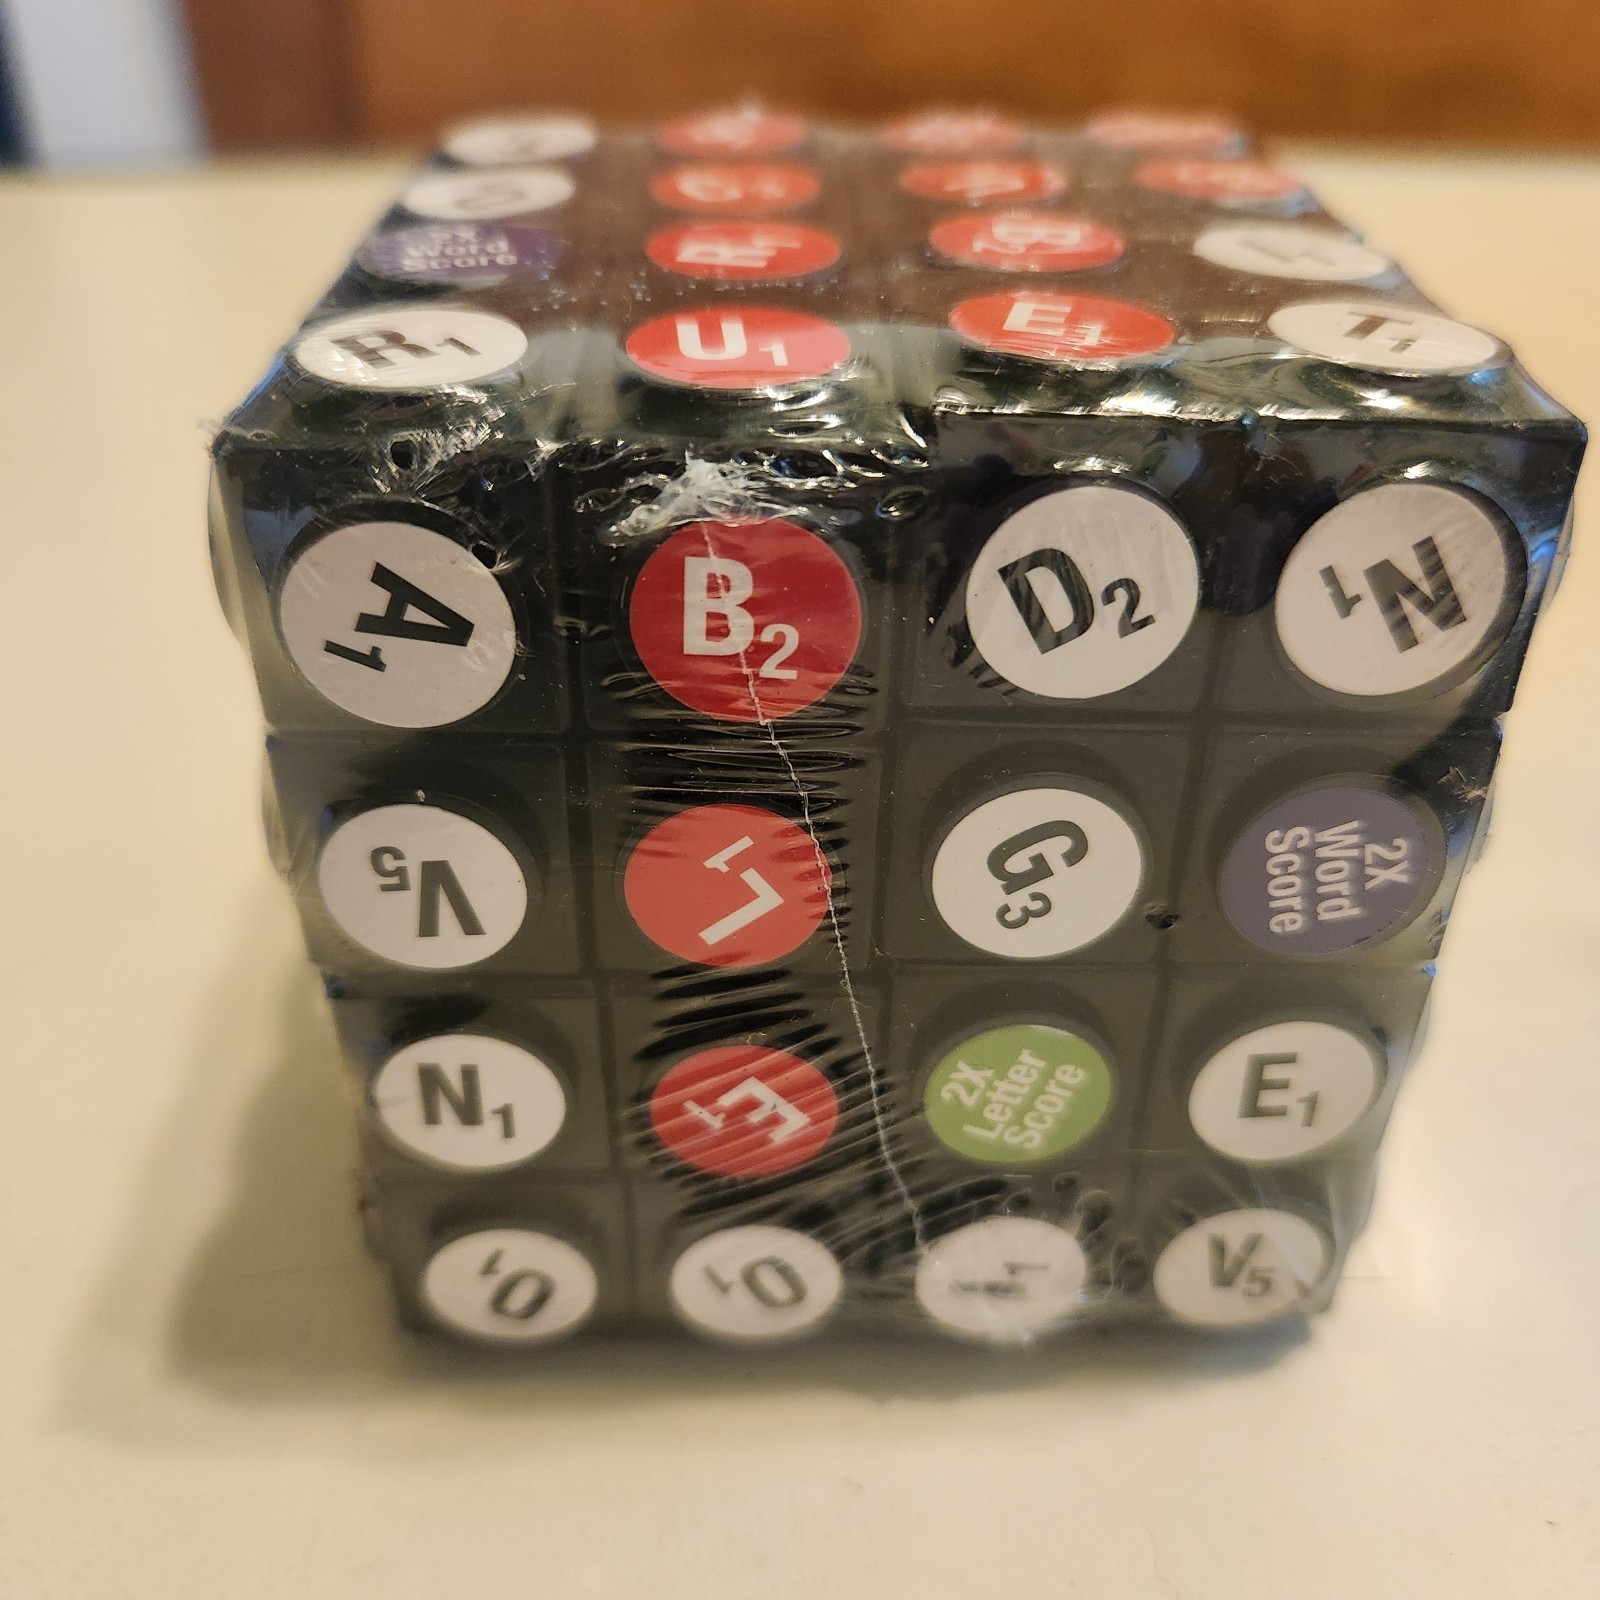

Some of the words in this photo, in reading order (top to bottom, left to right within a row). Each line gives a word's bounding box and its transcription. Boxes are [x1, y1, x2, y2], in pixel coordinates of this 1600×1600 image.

[401, 235, 509, 258] Word
[401, 251, 518, 272] Score
[1264, 825, 1310, 936] Score
[1314, 818, 1361, 922] Word
[1363, 836, 1409, 891] 2X
[940, 1060, 995, 1108] 2X
[962, 1046, 1047, 1142] Letter
[1004, 1063, 1086, 1150] Score
